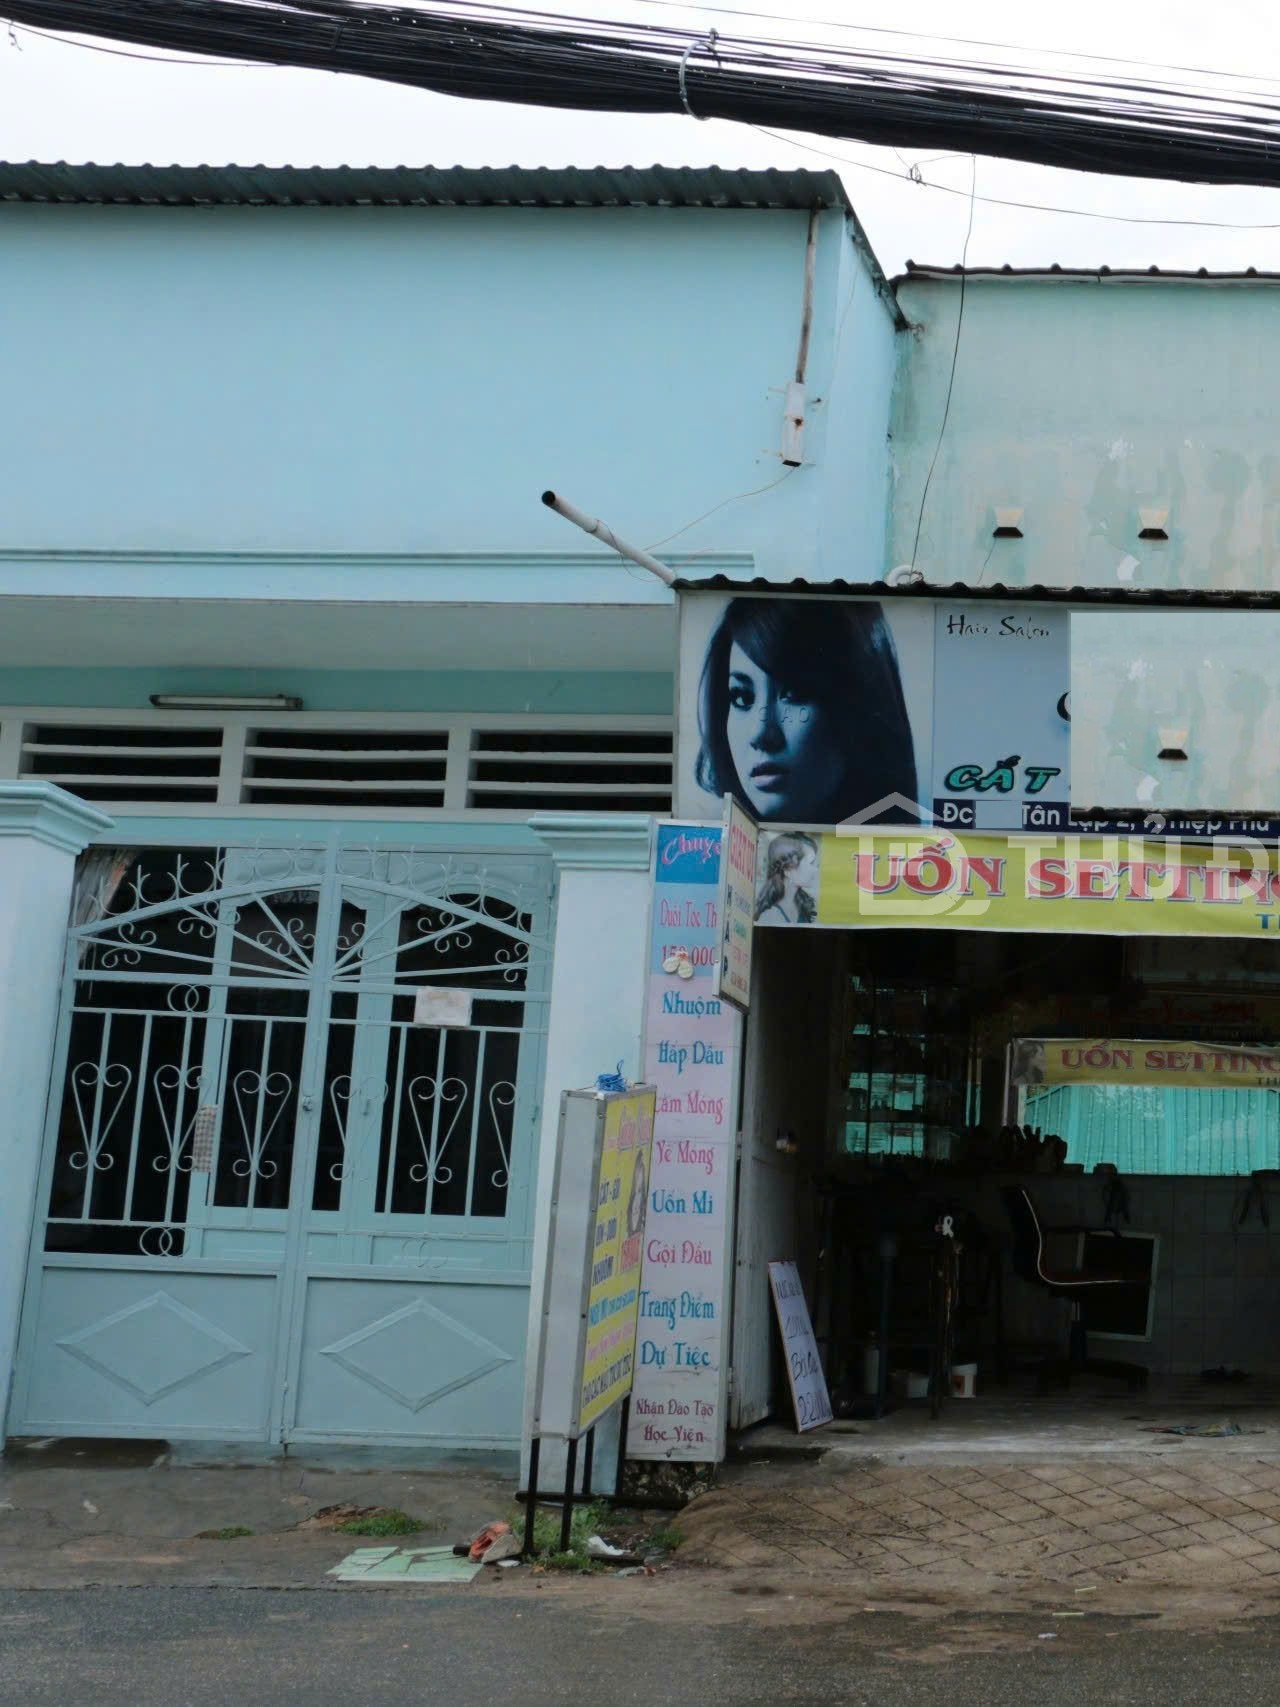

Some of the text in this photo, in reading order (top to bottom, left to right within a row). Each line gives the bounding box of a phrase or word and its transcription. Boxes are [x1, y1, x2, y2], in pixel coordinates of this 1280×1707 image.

[947, 614, 1050, 639] Hair Salon
[853, 837, 1006, 897] UỐN
[662, 990, 721, 1019] Nhuộm
[1061, 1039, 1134, 1070] UỐN
[652, 1188, 686, 1214] Uốn
[647, 1239, 676, 1268] Gội
[639, 1291, 676, 1330] Trang
[672, 1342, 711, 1370] Tiệc
[643, 1425, 668, 1444] Học
